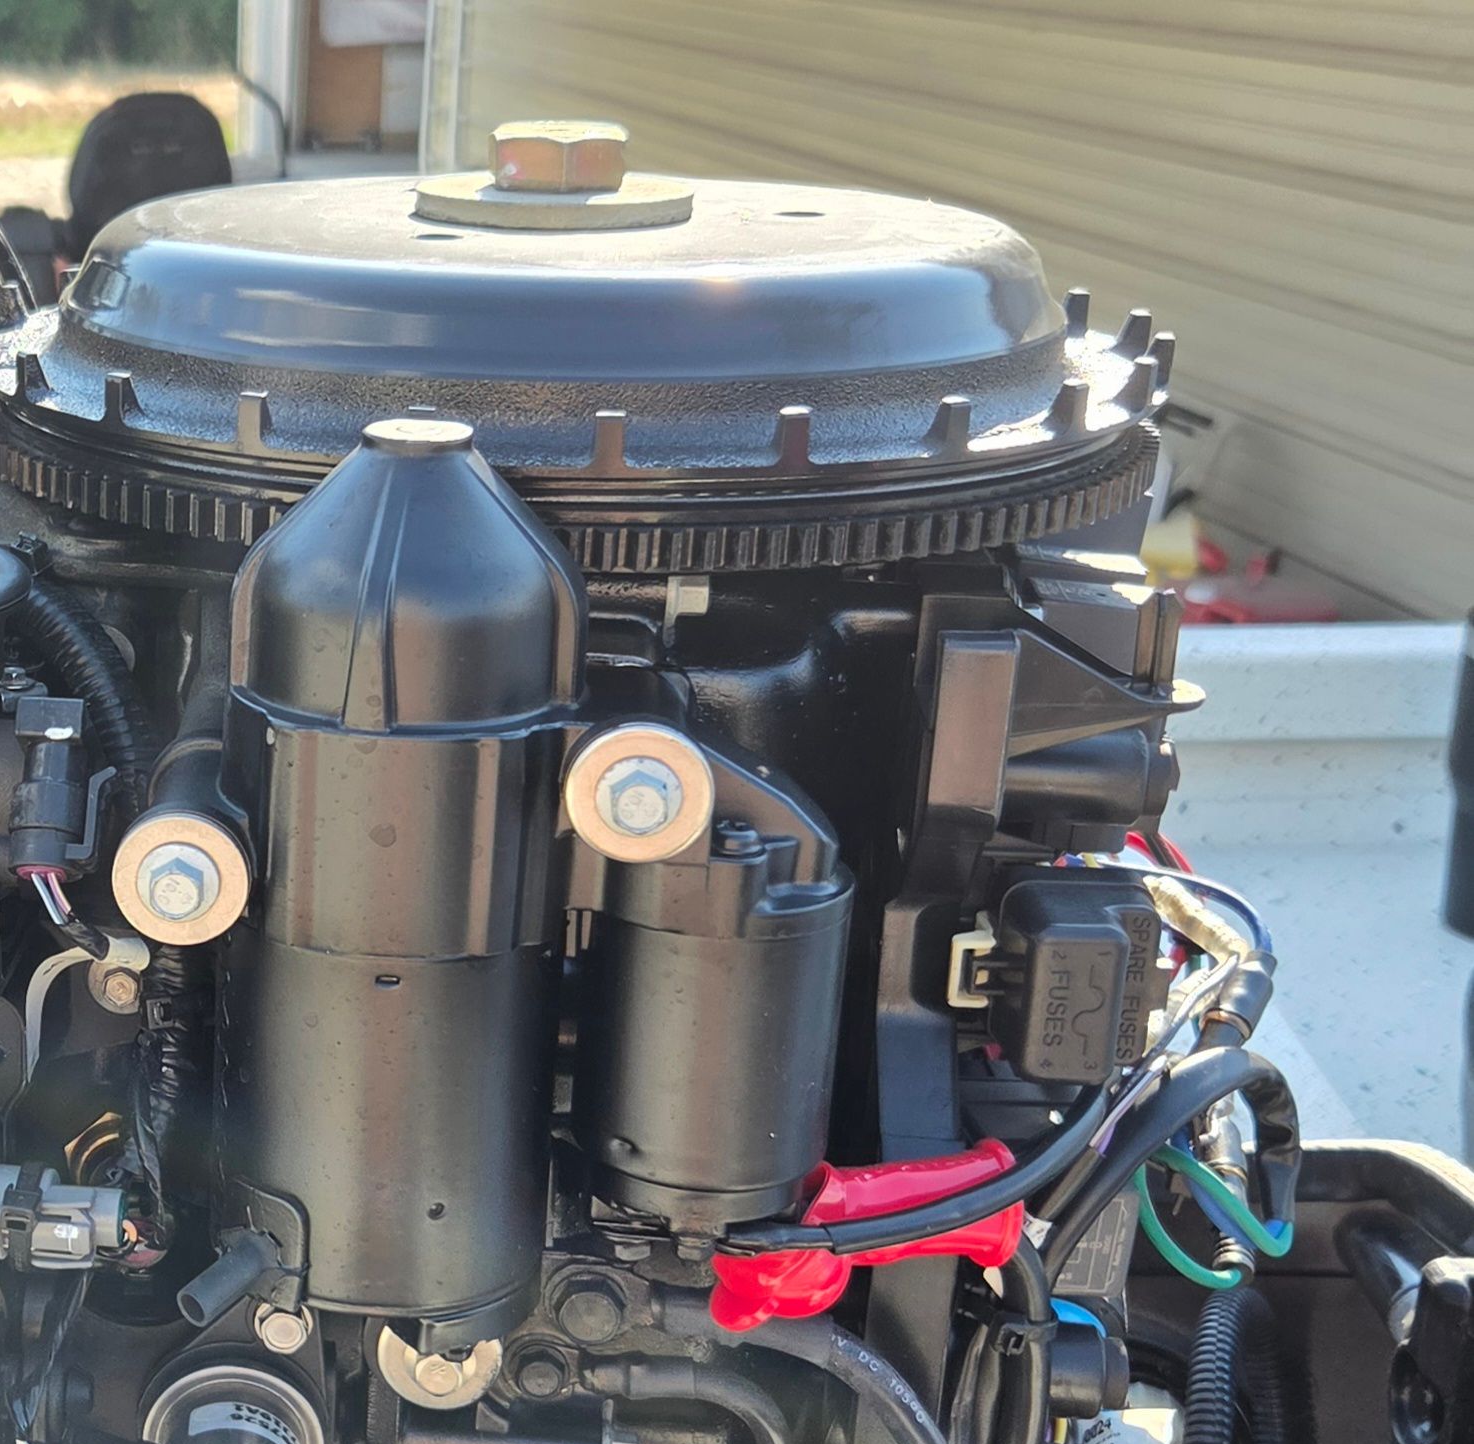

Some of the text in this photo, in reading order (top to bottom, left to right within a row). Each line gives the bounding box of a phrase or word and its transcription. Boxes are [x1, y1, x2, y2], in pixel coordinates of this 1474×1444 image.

[1042, 970, 1071, 1047] FUSES
[1116, 915, 1152, 1060] SPARE FUSES
